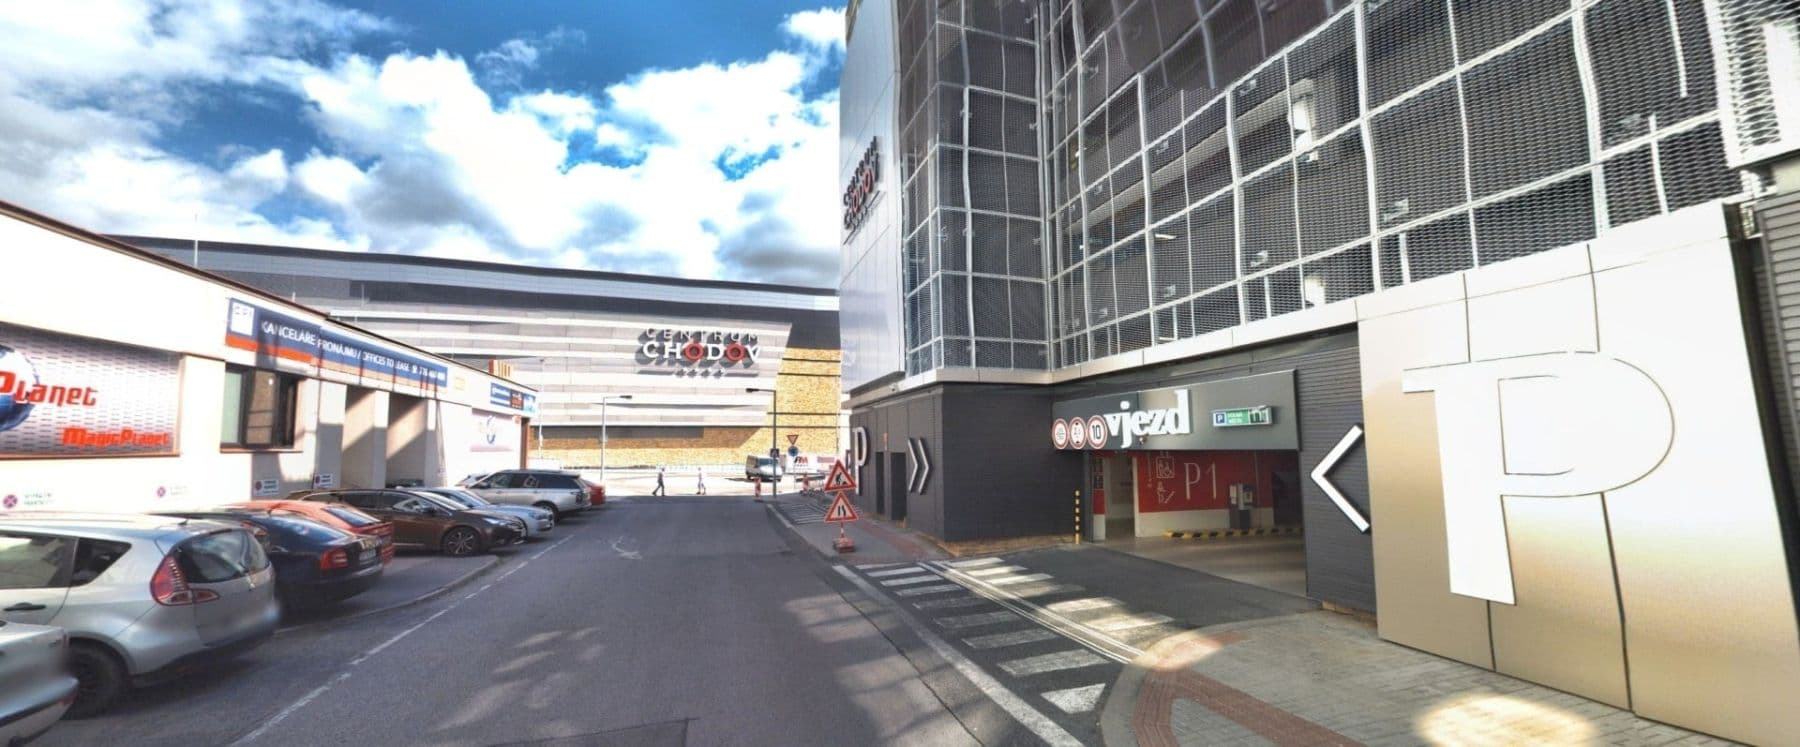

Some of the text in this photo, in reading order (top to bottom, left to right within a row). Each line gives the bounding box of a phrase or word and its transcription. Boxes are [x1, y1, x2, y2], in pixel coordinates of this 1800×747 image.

[642, 340, 760, 363] CHODOV
[645, 327, 760, 342] CENTRUM
[1092, 424, 1102, 440] 10
[1103, 389, 1190, 448] vjezd
[852, 426, 868, 495] P
[1401, 351, 1675, 606] P
[1184, 461, 1217, 500] P1
